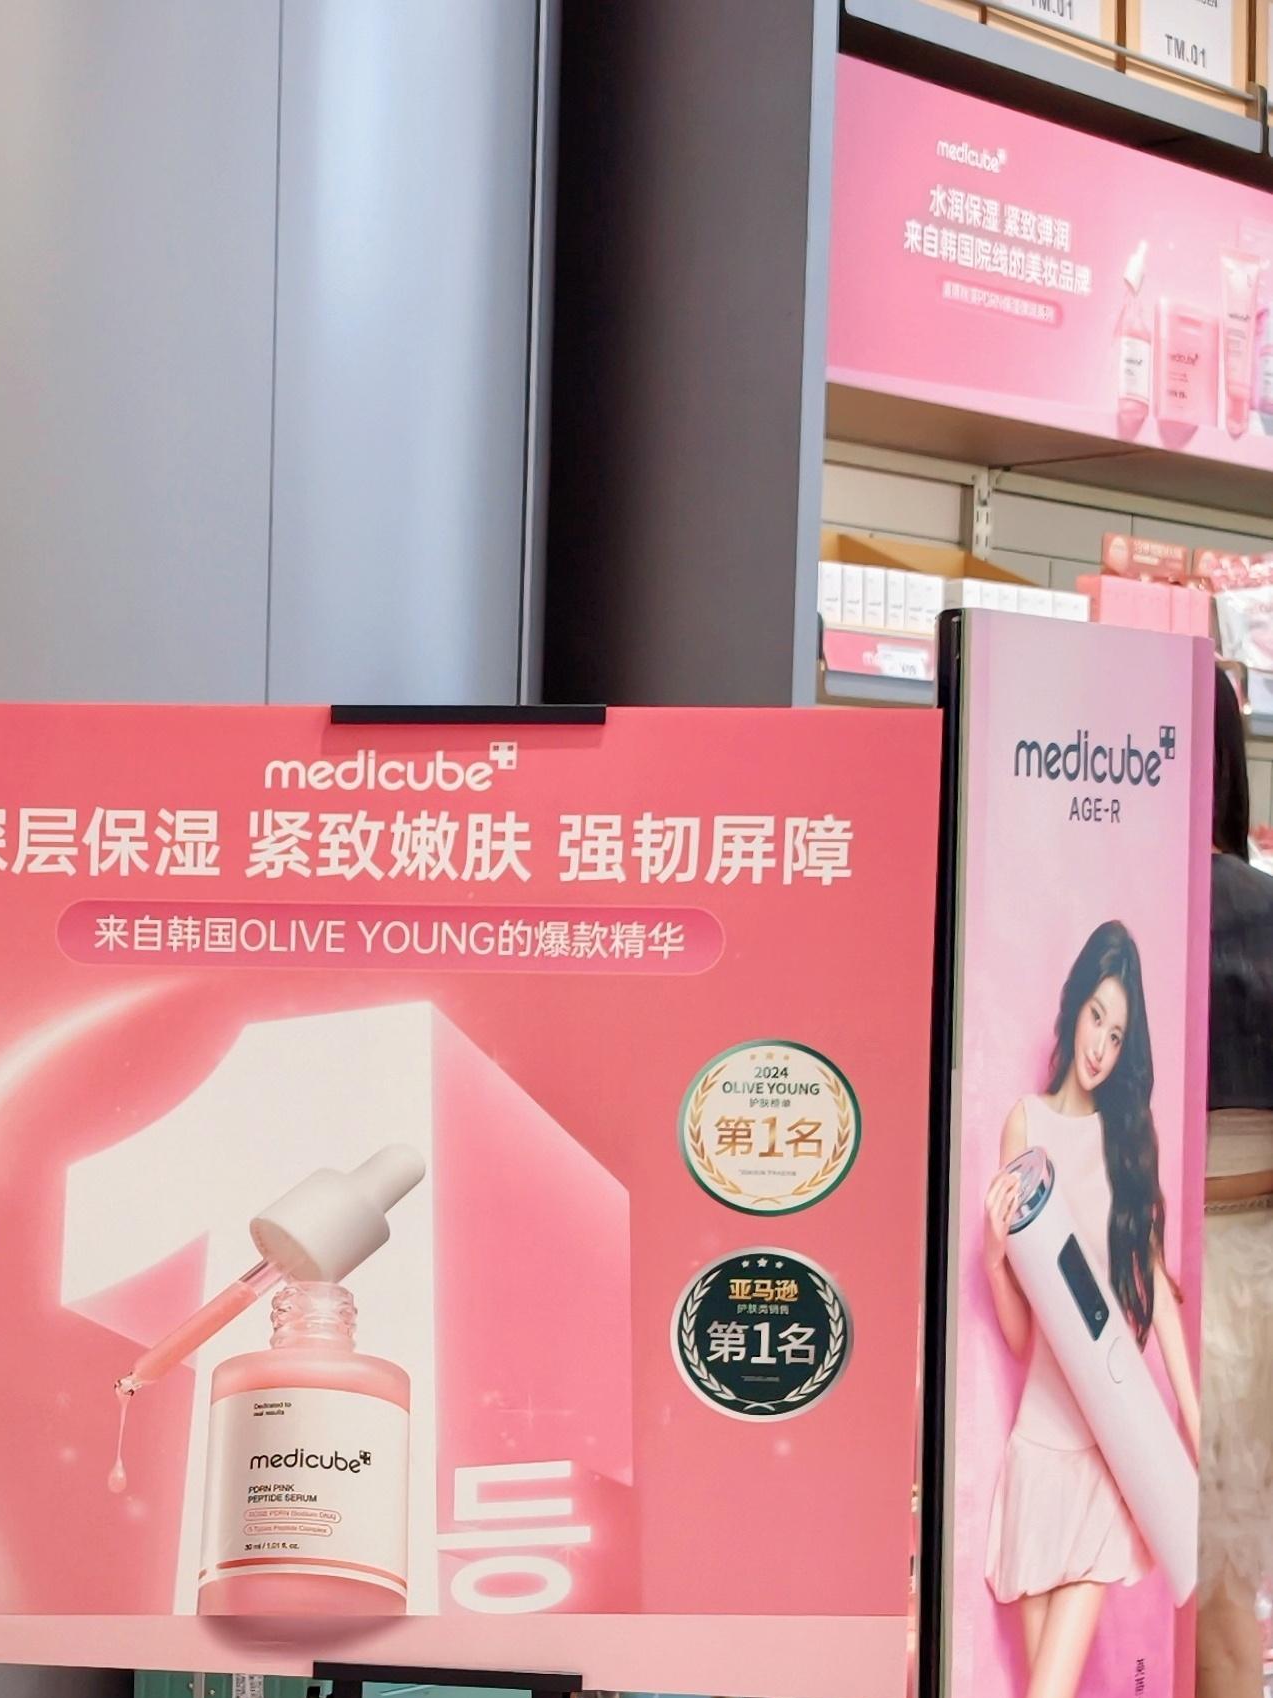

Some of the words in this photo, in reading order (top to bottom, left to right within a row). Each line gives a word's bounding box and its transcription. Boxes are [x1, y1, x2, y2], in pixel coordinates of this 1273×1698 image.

[1030, 0, 1072, 20] .01
[1165, 33, 1207, 68] TM.01
[936, 140, 1003, 173] medicube
[929, 184, 1000, 233] 水润保湿
[904, 218, 1092, 296] 来自韩国院线的美妆品牌
[265, 748, 495, 791] medicube
[1014, 729, 1163, 787] medicube
[1069, 796, 1121, 823] AGE-R
[245, 809, 531, 882] 紧致嫩肤
[559, 812, 853, 886] 强韧屏障
[722, 1081, 764, 1095] OLIVE
[766, 1082, 820, 1096] YOUNG
[754, 1066, 788, 1079] 2024
[713, 1115, 823, 1159] 第1名
[728, 1278, 799, 1303] 亚马逊
[706, 1321, 817, 1366] 第1名
[250, 1448, 361, 1473] medicube
[247, 1494, 283, 1503] PEPTIDE
[285, 1494, 318, 1502] SERUM
[273, 1483, 295, 1492] PINK
